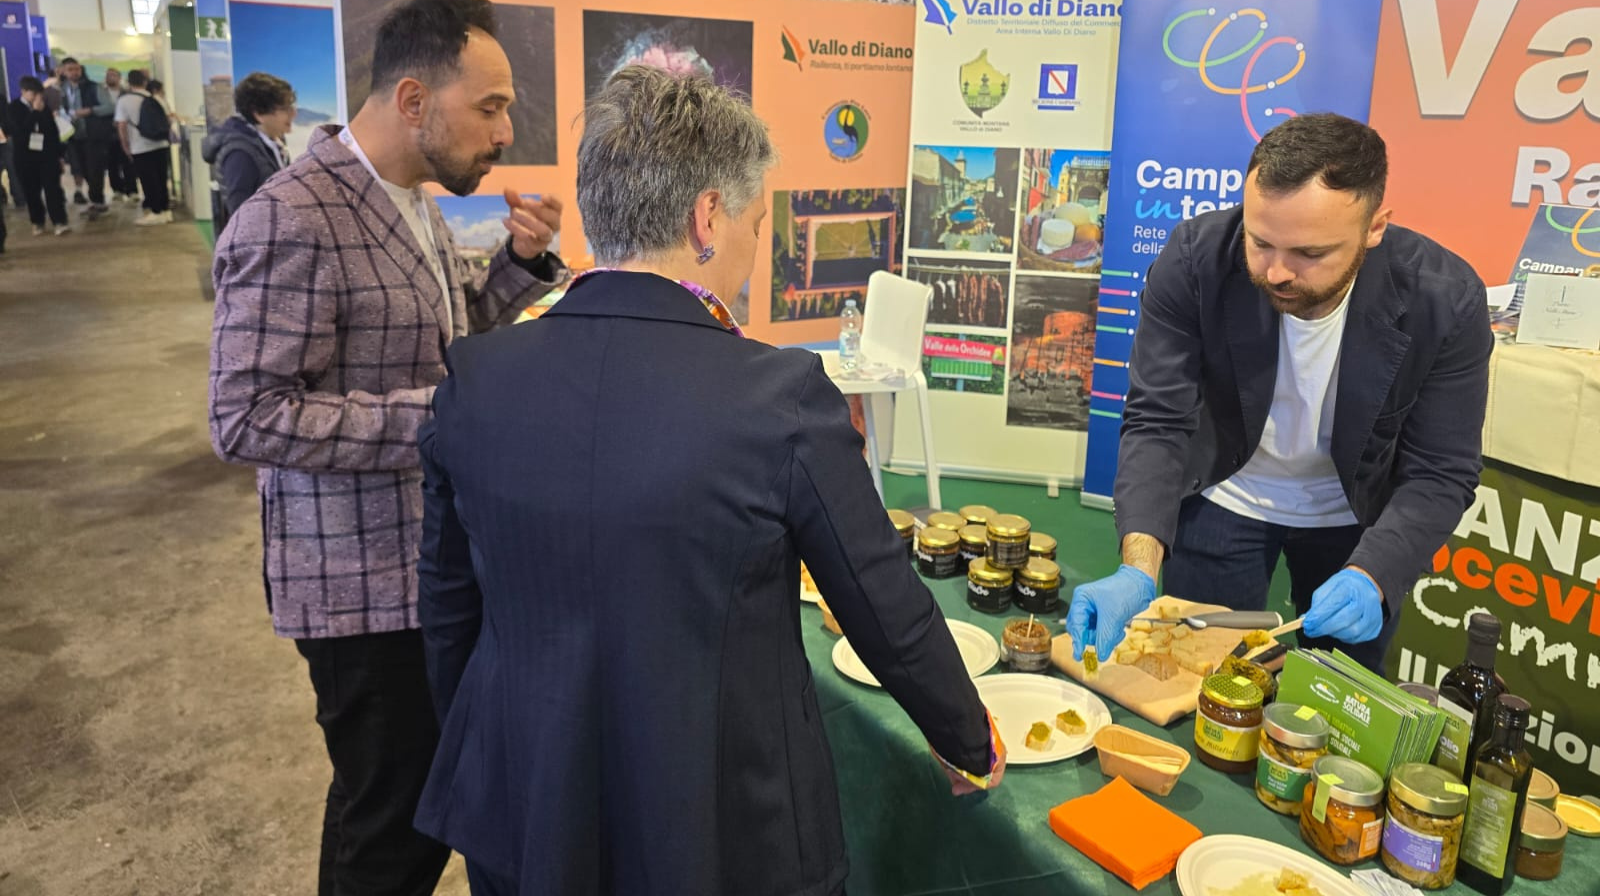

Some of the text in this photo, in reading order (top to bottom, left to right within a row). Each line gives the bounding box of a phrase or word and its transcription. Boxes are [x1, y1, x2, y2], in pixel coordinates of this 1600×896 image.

[962, 0, 1024, 16] Vallo
[1028, 0, 1051, 16] di
[808, 38, 913, 59] Vallo di Diano
[1136, 159, 1243, 199] Camp
[1133, 224, 1167, 240] Rete
[924, 338, 943, 351] Valle
